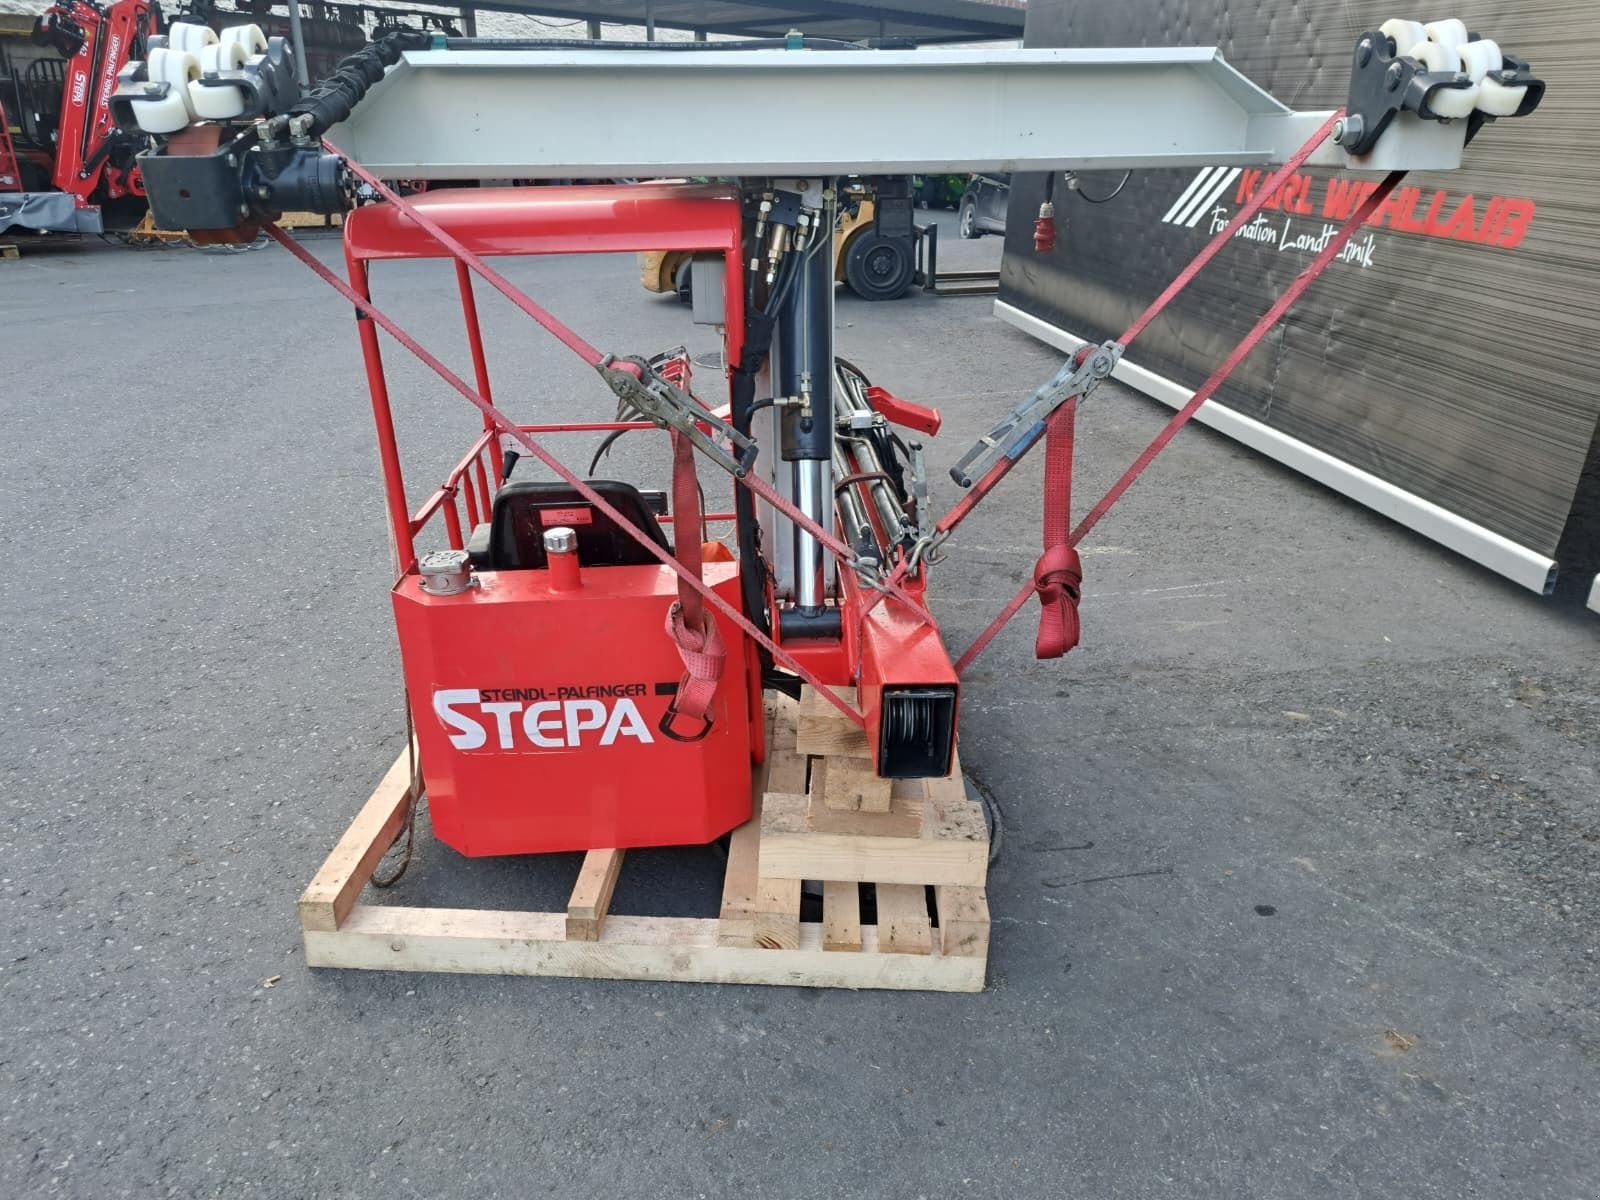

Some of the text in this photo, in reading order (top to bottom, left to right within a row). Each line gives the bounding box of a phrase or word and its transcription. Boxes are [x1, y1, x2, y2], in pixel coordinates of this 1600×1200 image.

[72, 73, 86, 104] STEPA
[1209, 205, 1377, 267] Fanation Landthnik
[432, 688, 656, 751] STEPA
